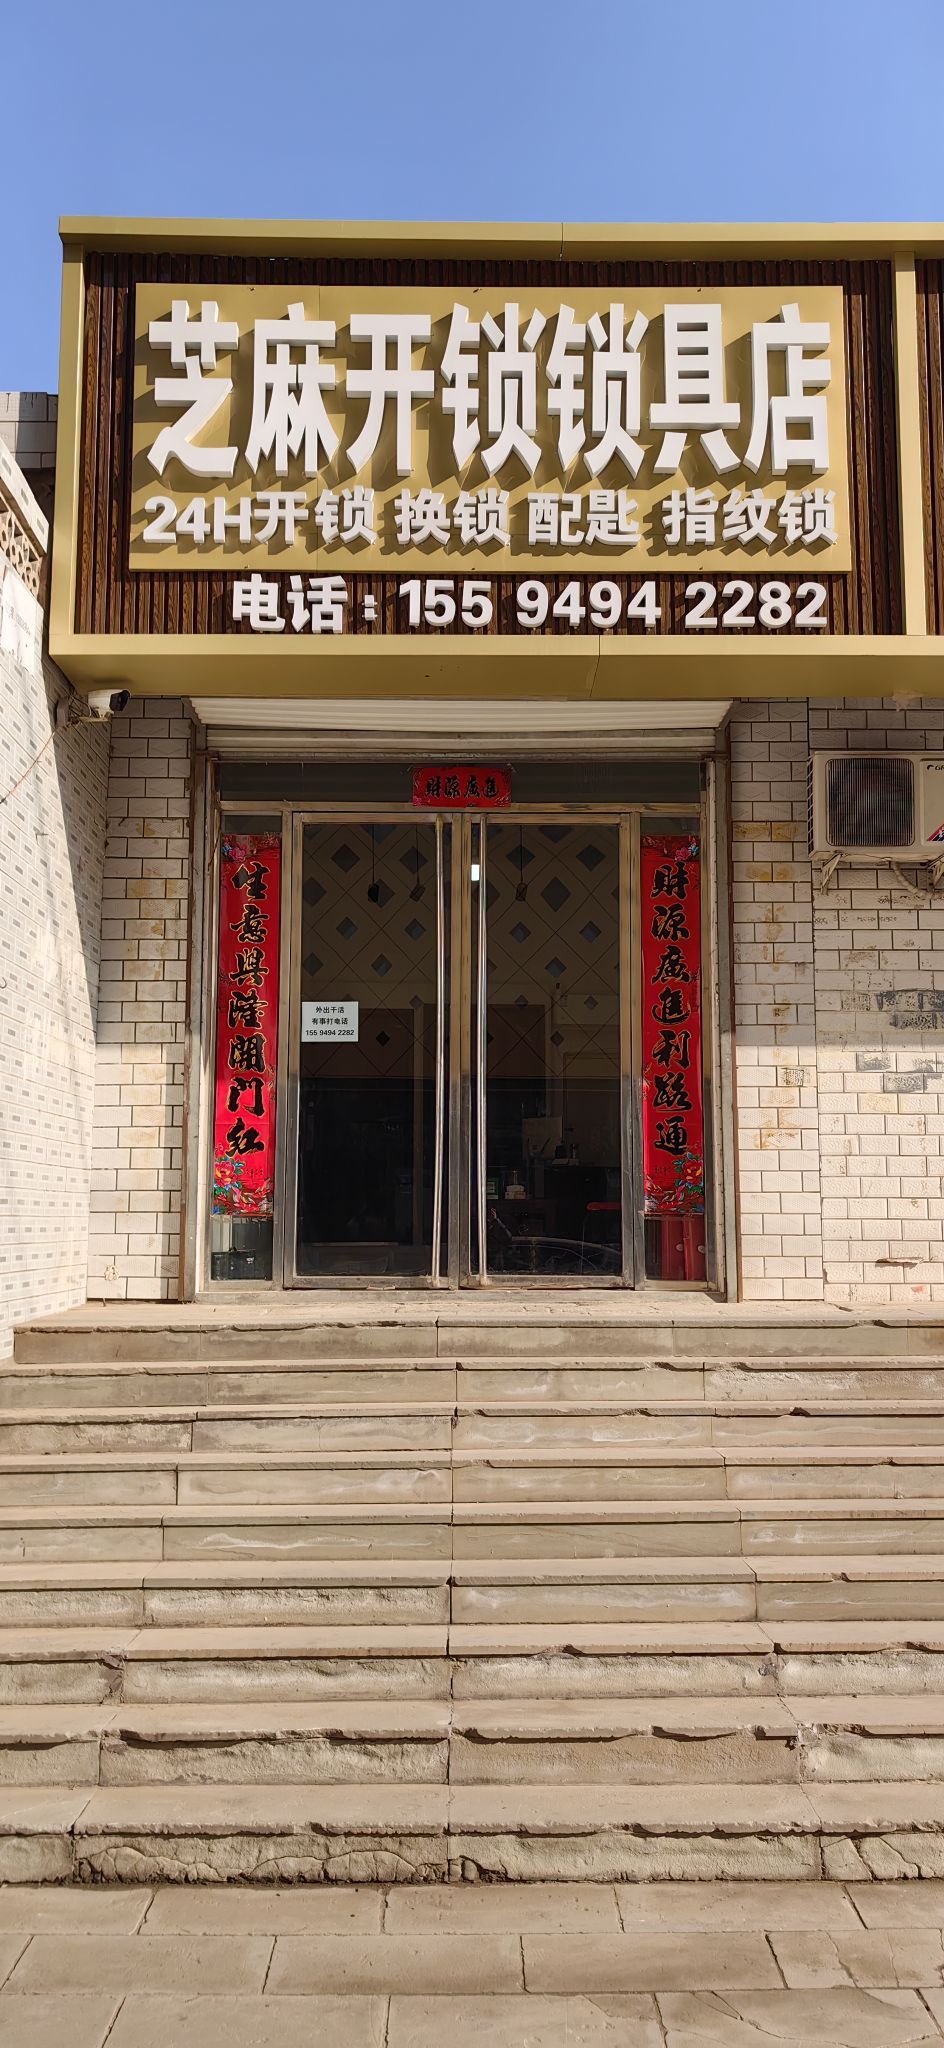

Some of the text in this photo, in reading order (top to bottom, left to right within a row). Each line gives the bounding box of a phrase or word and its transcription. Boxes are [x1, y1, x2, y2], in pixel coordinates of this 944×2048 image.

[147, 299, 831, 478] 芝麻开锁锁具店
[394, 486, 511, 546] 换锁
[527, 488, 642, 546] 配匙
[661, 486, 839, 546] 指纹锁
[399, 578, 493, 628] 155
[516, 580, 662, 629] 9494
[684, 580, 829, 629] 2282
[311, 1017, 349, 1025] 有事打电话
[315, 1006, 345, 1014] 外出干活
